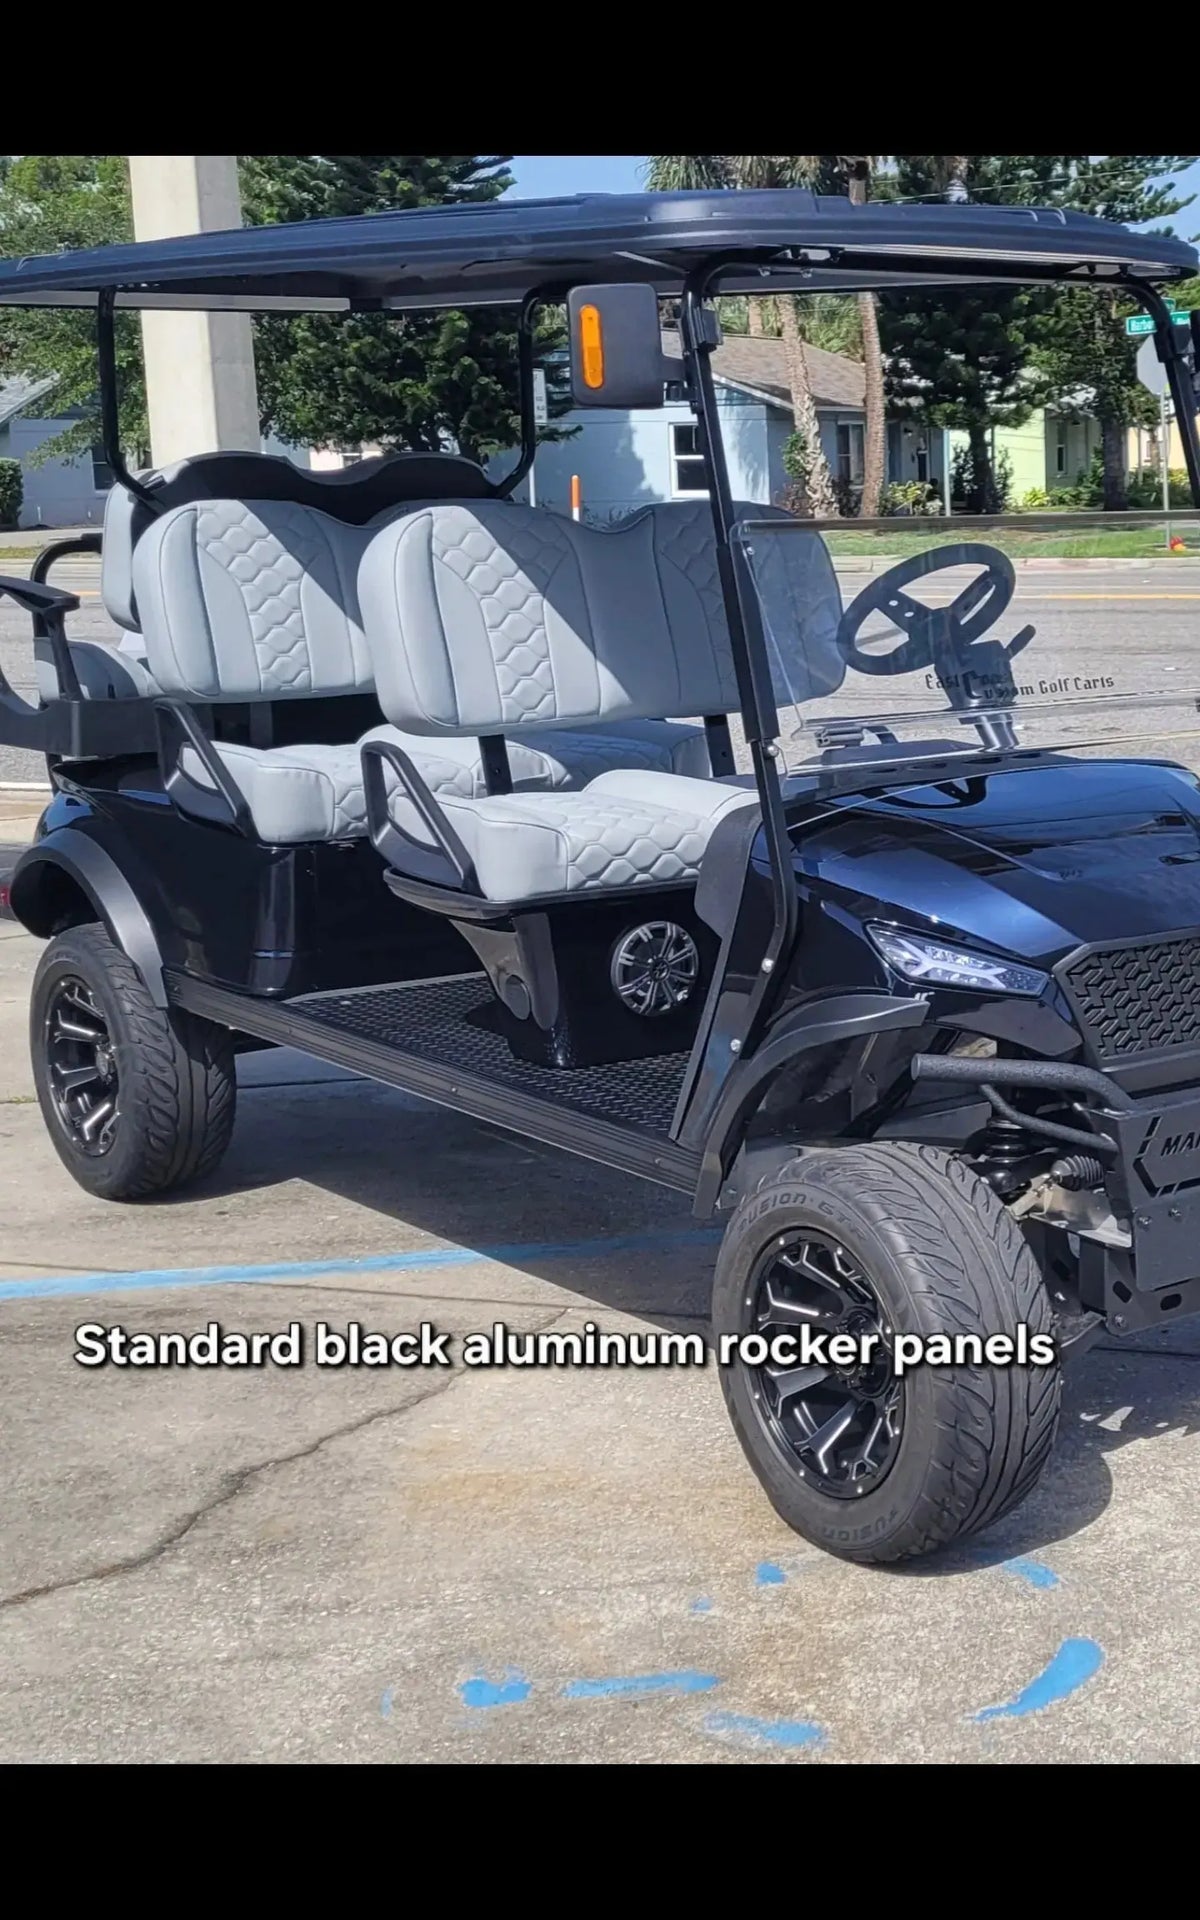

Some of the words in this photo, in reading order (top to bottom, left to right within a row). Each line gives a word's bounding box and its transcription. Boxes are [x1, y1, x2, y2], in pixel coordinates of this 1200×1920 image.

[925, 674, 960, 690] East
[1039, 677, 1071, 695] Golf
[1074, 676, 1115, 690] Carts
[1160, 1131, 1200, 1157] MA
